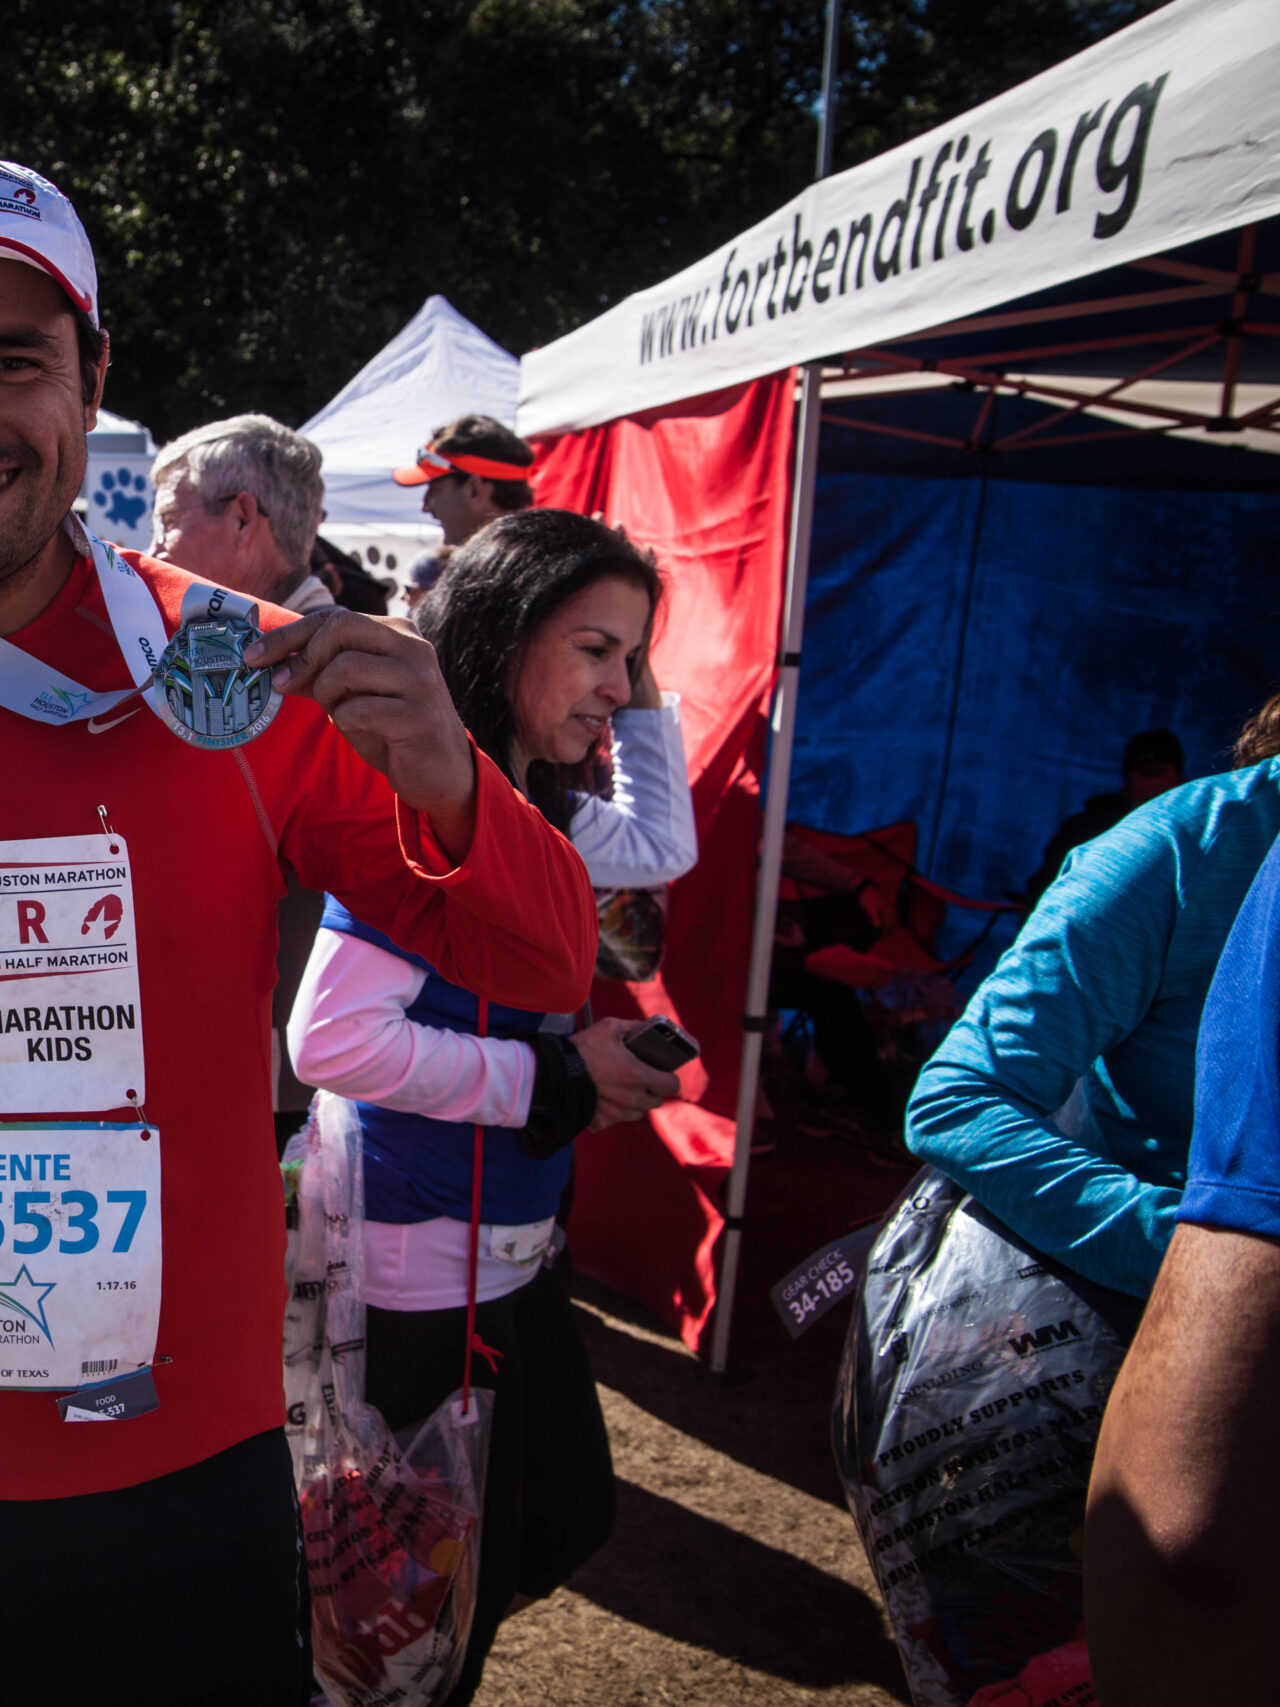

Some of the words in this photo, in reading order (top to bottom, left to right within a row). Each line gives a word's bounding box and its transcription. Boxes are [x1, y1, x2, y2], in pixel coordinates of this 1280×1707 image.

[638, 69, 1171, 367] www.fortbendfit.org
[33, 697, 69, 714] HOUSTON
[173, 722, 193, 742] 13.1
[196, 731, 249, 748] FINISHER
[249, 715, 271, 736] 2016
[44, 866, 127, 885] MARATHON
[5, 956, 43, 970] HALF
[47, 951, 129, 967] MARATHON
[27, 1037, 92, 1062] KIDS
[96, 1281, 137, 1291] 1.17.16
[782, 1275, 809, 1302] GEAR
[808, 1248, 844, 1280] CHECK
[788, 1260, 856, 1325] 34-185
[1007, 1319, 1082, 1355] WM
[1, 1369, 14, 1378] OF
[17, 1369, 49, 1379] TEXAS
[899, 1359, 985, 1402] SPALDING
[95, 1394, 116, 1407] FOOD
[98, 1403, 126, 1417] 5-537
[878, 1416, 965, 1469] PROUDLY
[969, 1369, 1086, 1427] SUPPORTS
[870, 1469, 940, 1517] CHEVRON
[946, 1424, 1044, 1478] HOUSTON
[893, 1493, 973, 1541] HOUSTON
